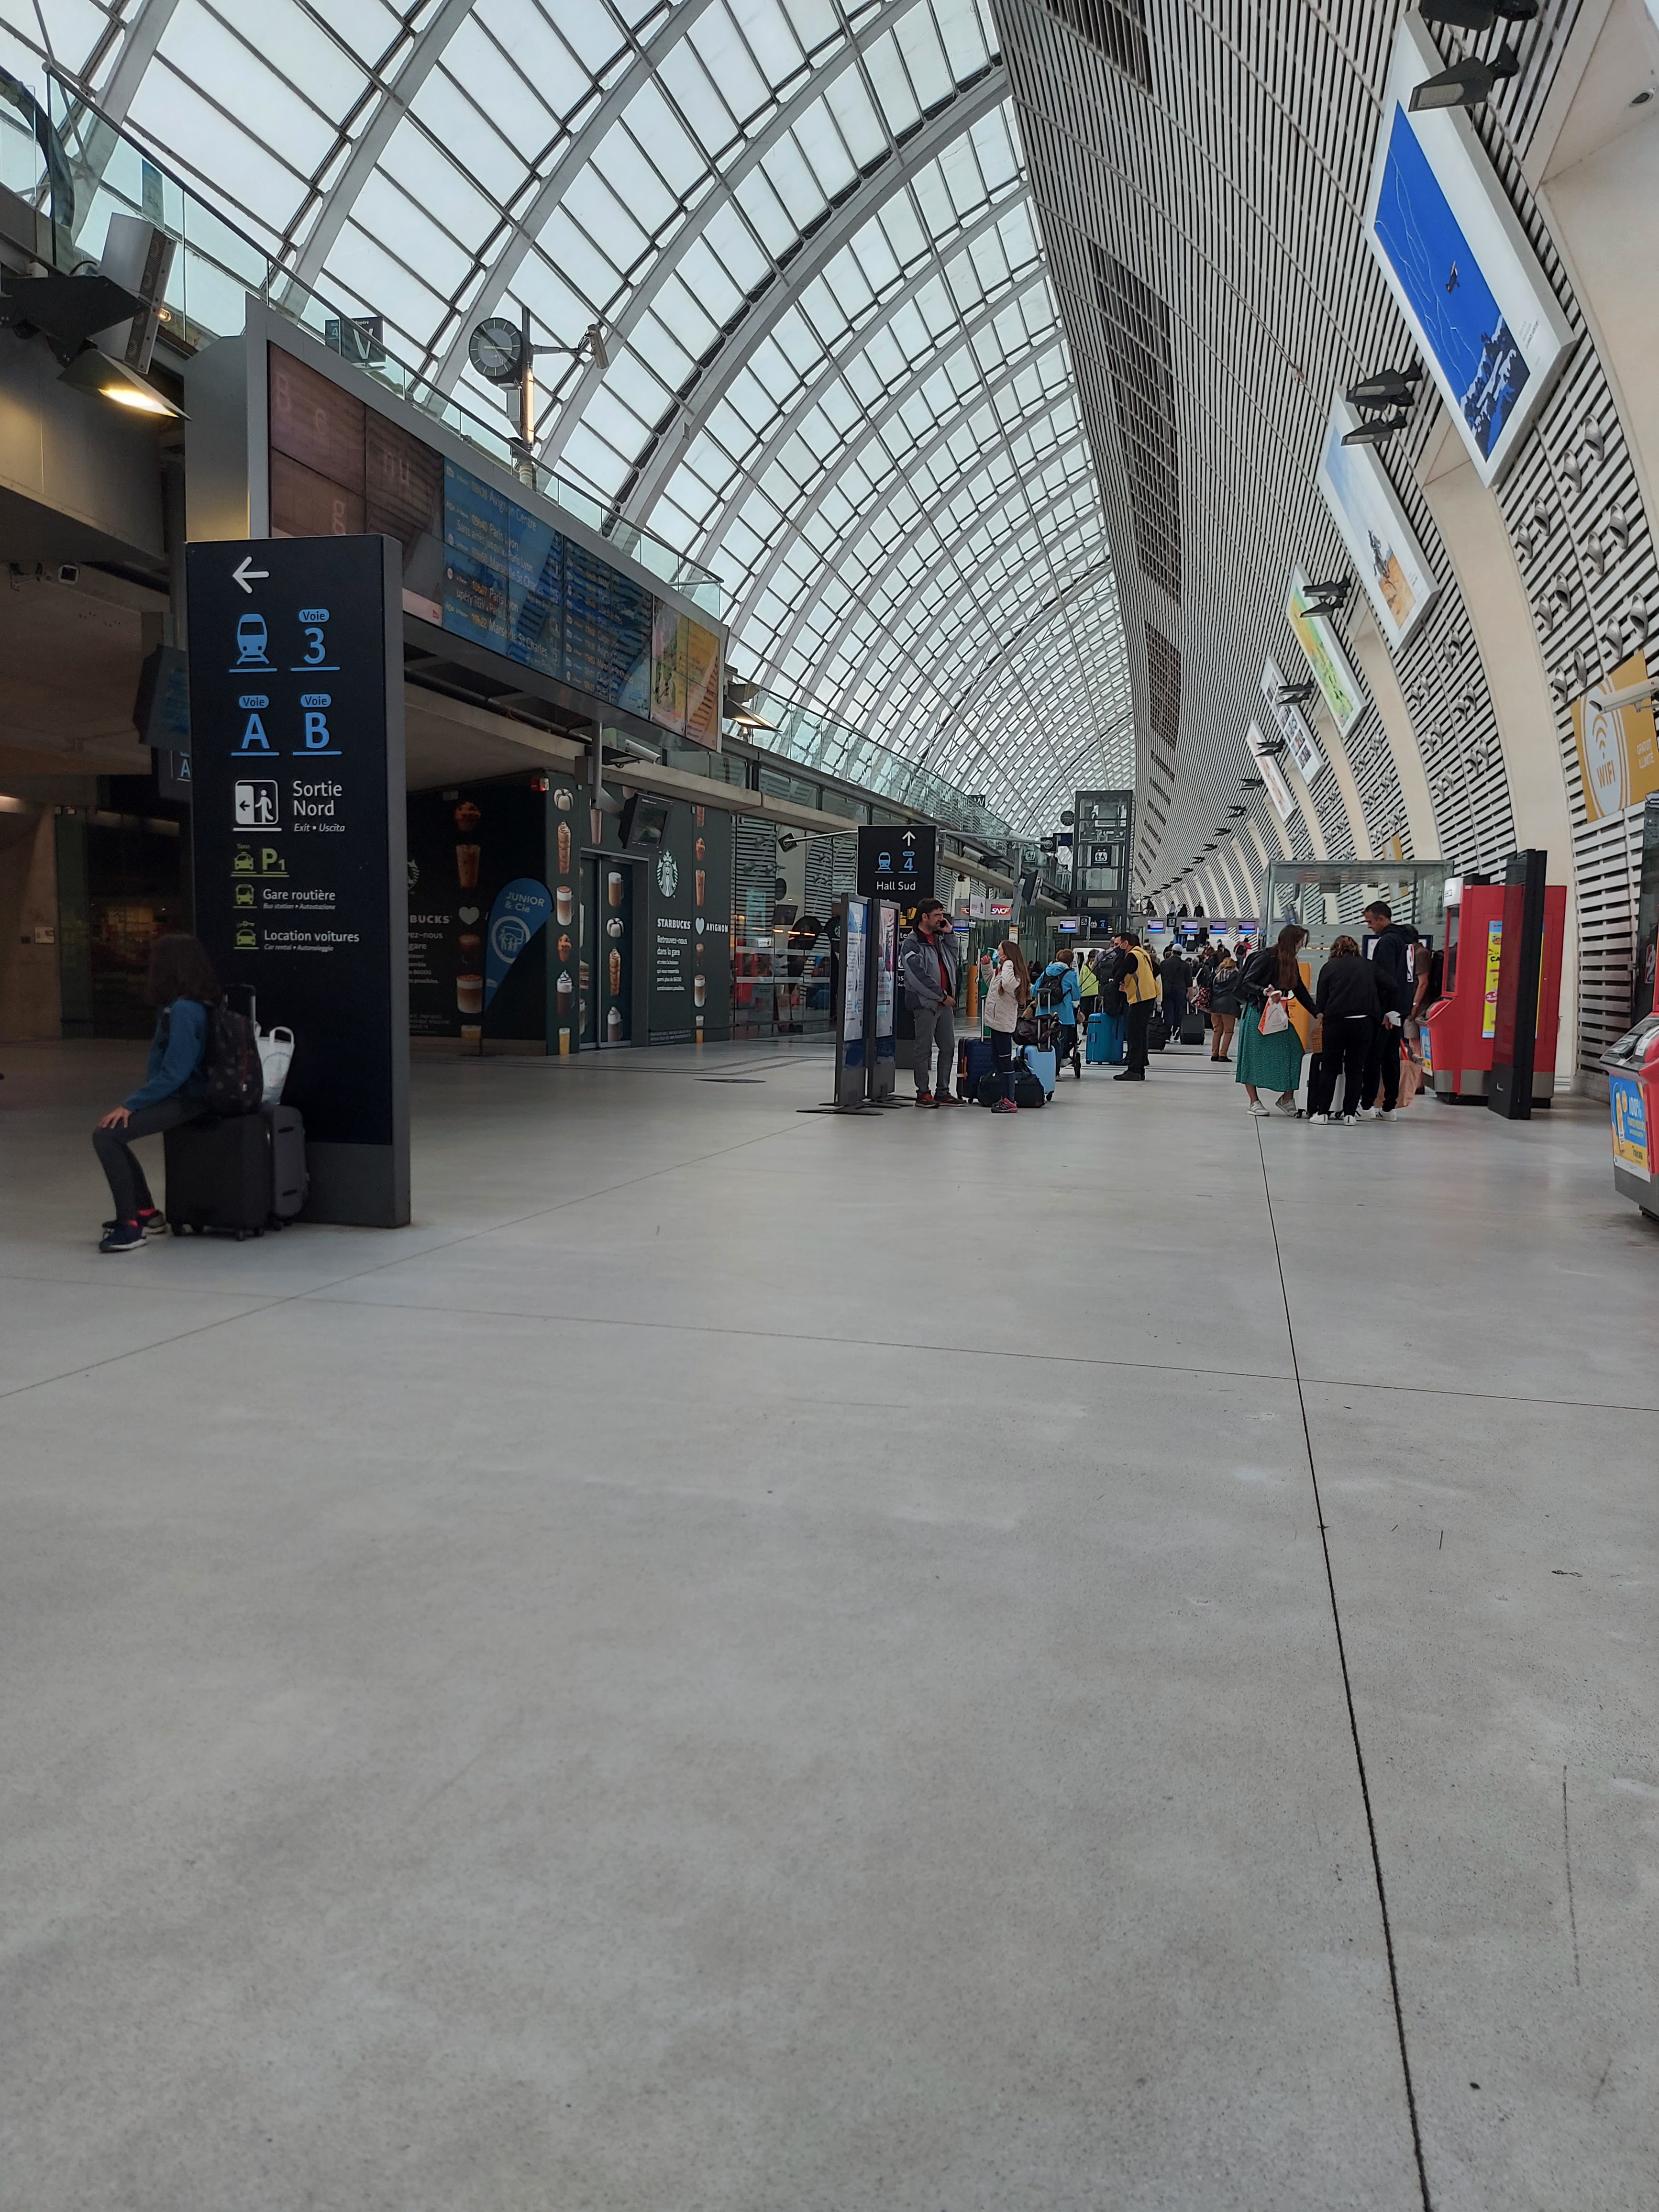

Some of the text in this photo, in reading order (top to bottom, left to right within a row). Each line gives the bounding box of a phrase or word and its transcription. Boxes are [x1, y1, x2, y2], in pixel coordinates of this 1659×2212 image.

[331, 327, 339, 337] 4
[353, 328, 373, 359] V
[516, 509, 536, 531] Centre
[489, 524, 503, 541] Paris
[457, 519, 470, 536] Sans
[508, 551, 520, 565] Paris
[520, 558, 533, 573] Lyon
[456, 587, 473, 605] upéry
[474, 595, 485, 610] TGV
[489, 587, 503, 605] Paris
[303, 611, 325, 620] Voie
[303, 627, 326, 664] 3
[518, 632, 526, 647] St
[526, 637, 547, 656] Charles
[243, 696, 327, 707] Voie Voie
[241, 712, 330, 749] A B
[181, 759, 190, 777] A
[1596, 760, 1616, 789] WIFI
[293, 780, 343, 796] Sortie
[293, 799, 335, 816] Nord
[294, 823, 345, 832] Exit Uscita
[904, 858, 913, 871] 4
[263, 888, 336, 901] Gare routière
[876, 881, 916, 891] Hall Sud
[505, 900, 531, 913] & Cie
[506, 891, 545, 907] JUNIOR
[657, 918, 729, 933] STARBUCKS AVIGNON
[264, 930, 360, 942] Location voitures
[1629, 1096, 1643, 1119] 100%
